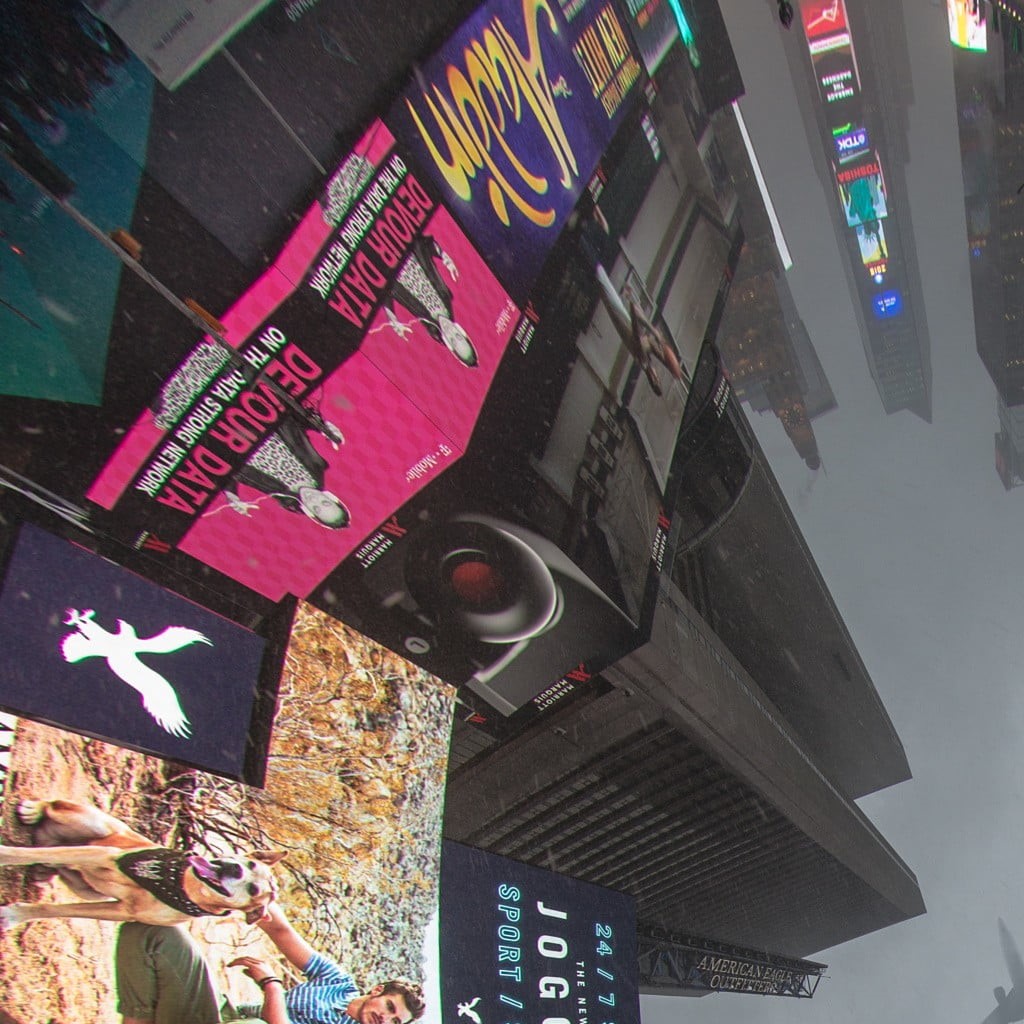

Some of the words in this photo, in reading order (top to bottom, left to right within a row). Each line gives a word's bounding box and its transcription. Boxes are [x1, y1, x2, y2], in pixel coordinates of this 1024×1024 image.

[593, 2, 630, 70] NEW
[832, 82, 844, 90] THE
[835, 135, 860, 149] TDK
[376, 165, 397, 194] THE
[385, 153, 407, 180] ON
[836, 163, 880, 181] TOSHIBA
[362, 181, 387, 215] DATA
[365, 172, 434, 272] DEVOUR
[310, 240, 351, 298] NETWORK
[325, 249, 388, 328] DATA
[257, 323, 286, 352] ON
[513, 315, 529, 343] MARQUIS
[519, 323, 535, 354] MARRIOTT
[241, 342, 270, 369] TH
[207, 341, 322, 455] DEVOUR
[134, 438, 187, 495] NETWORK
[155, 443, 232, 515] DATA
[354, 531, 384, 559] MARQUIS
[361, 538, 392, 568] MARRIOTT
[651, 526, 661, 560] MARQUIS
[655, 532, 666, 571] MARRIOTT
[533, 678, 567, 704] MARQUIS
[536, 684, 574, 711] MARRIOTT
[497, 882, 521, 981] SPORT
[595, 923, 613, 956] 24
[575, 961, 584, 987] THE
[598, 992, 614, 1006] 7
